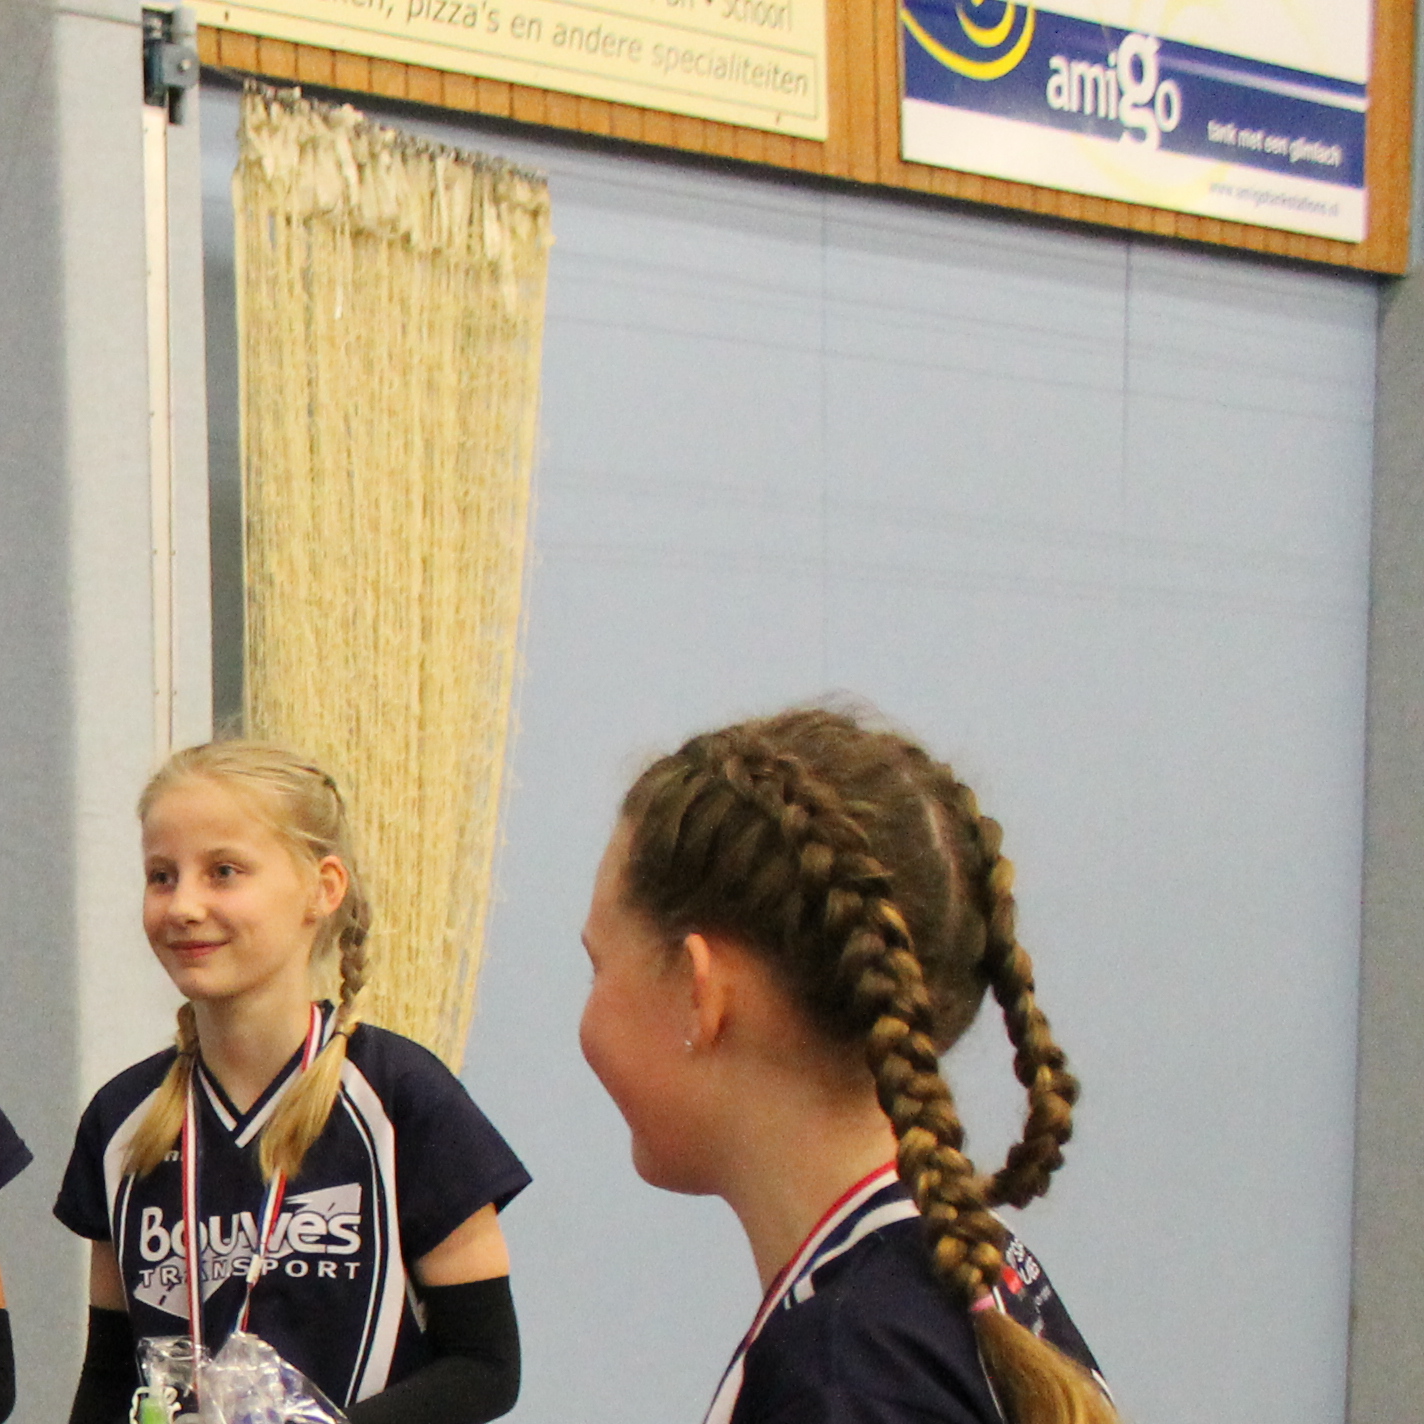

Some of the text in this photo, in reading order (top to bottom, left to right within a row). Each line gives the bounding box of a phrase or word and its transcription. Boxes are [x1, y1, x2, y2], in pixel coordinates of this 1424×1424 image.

[407, 0, 499, 33] pizza's
[510, 20, 543, 43] en
[553, 21, 642, 62] andere
[651, 42, 809, 97] specialiteiten
[1046, 32, 1182, 150] amigo
